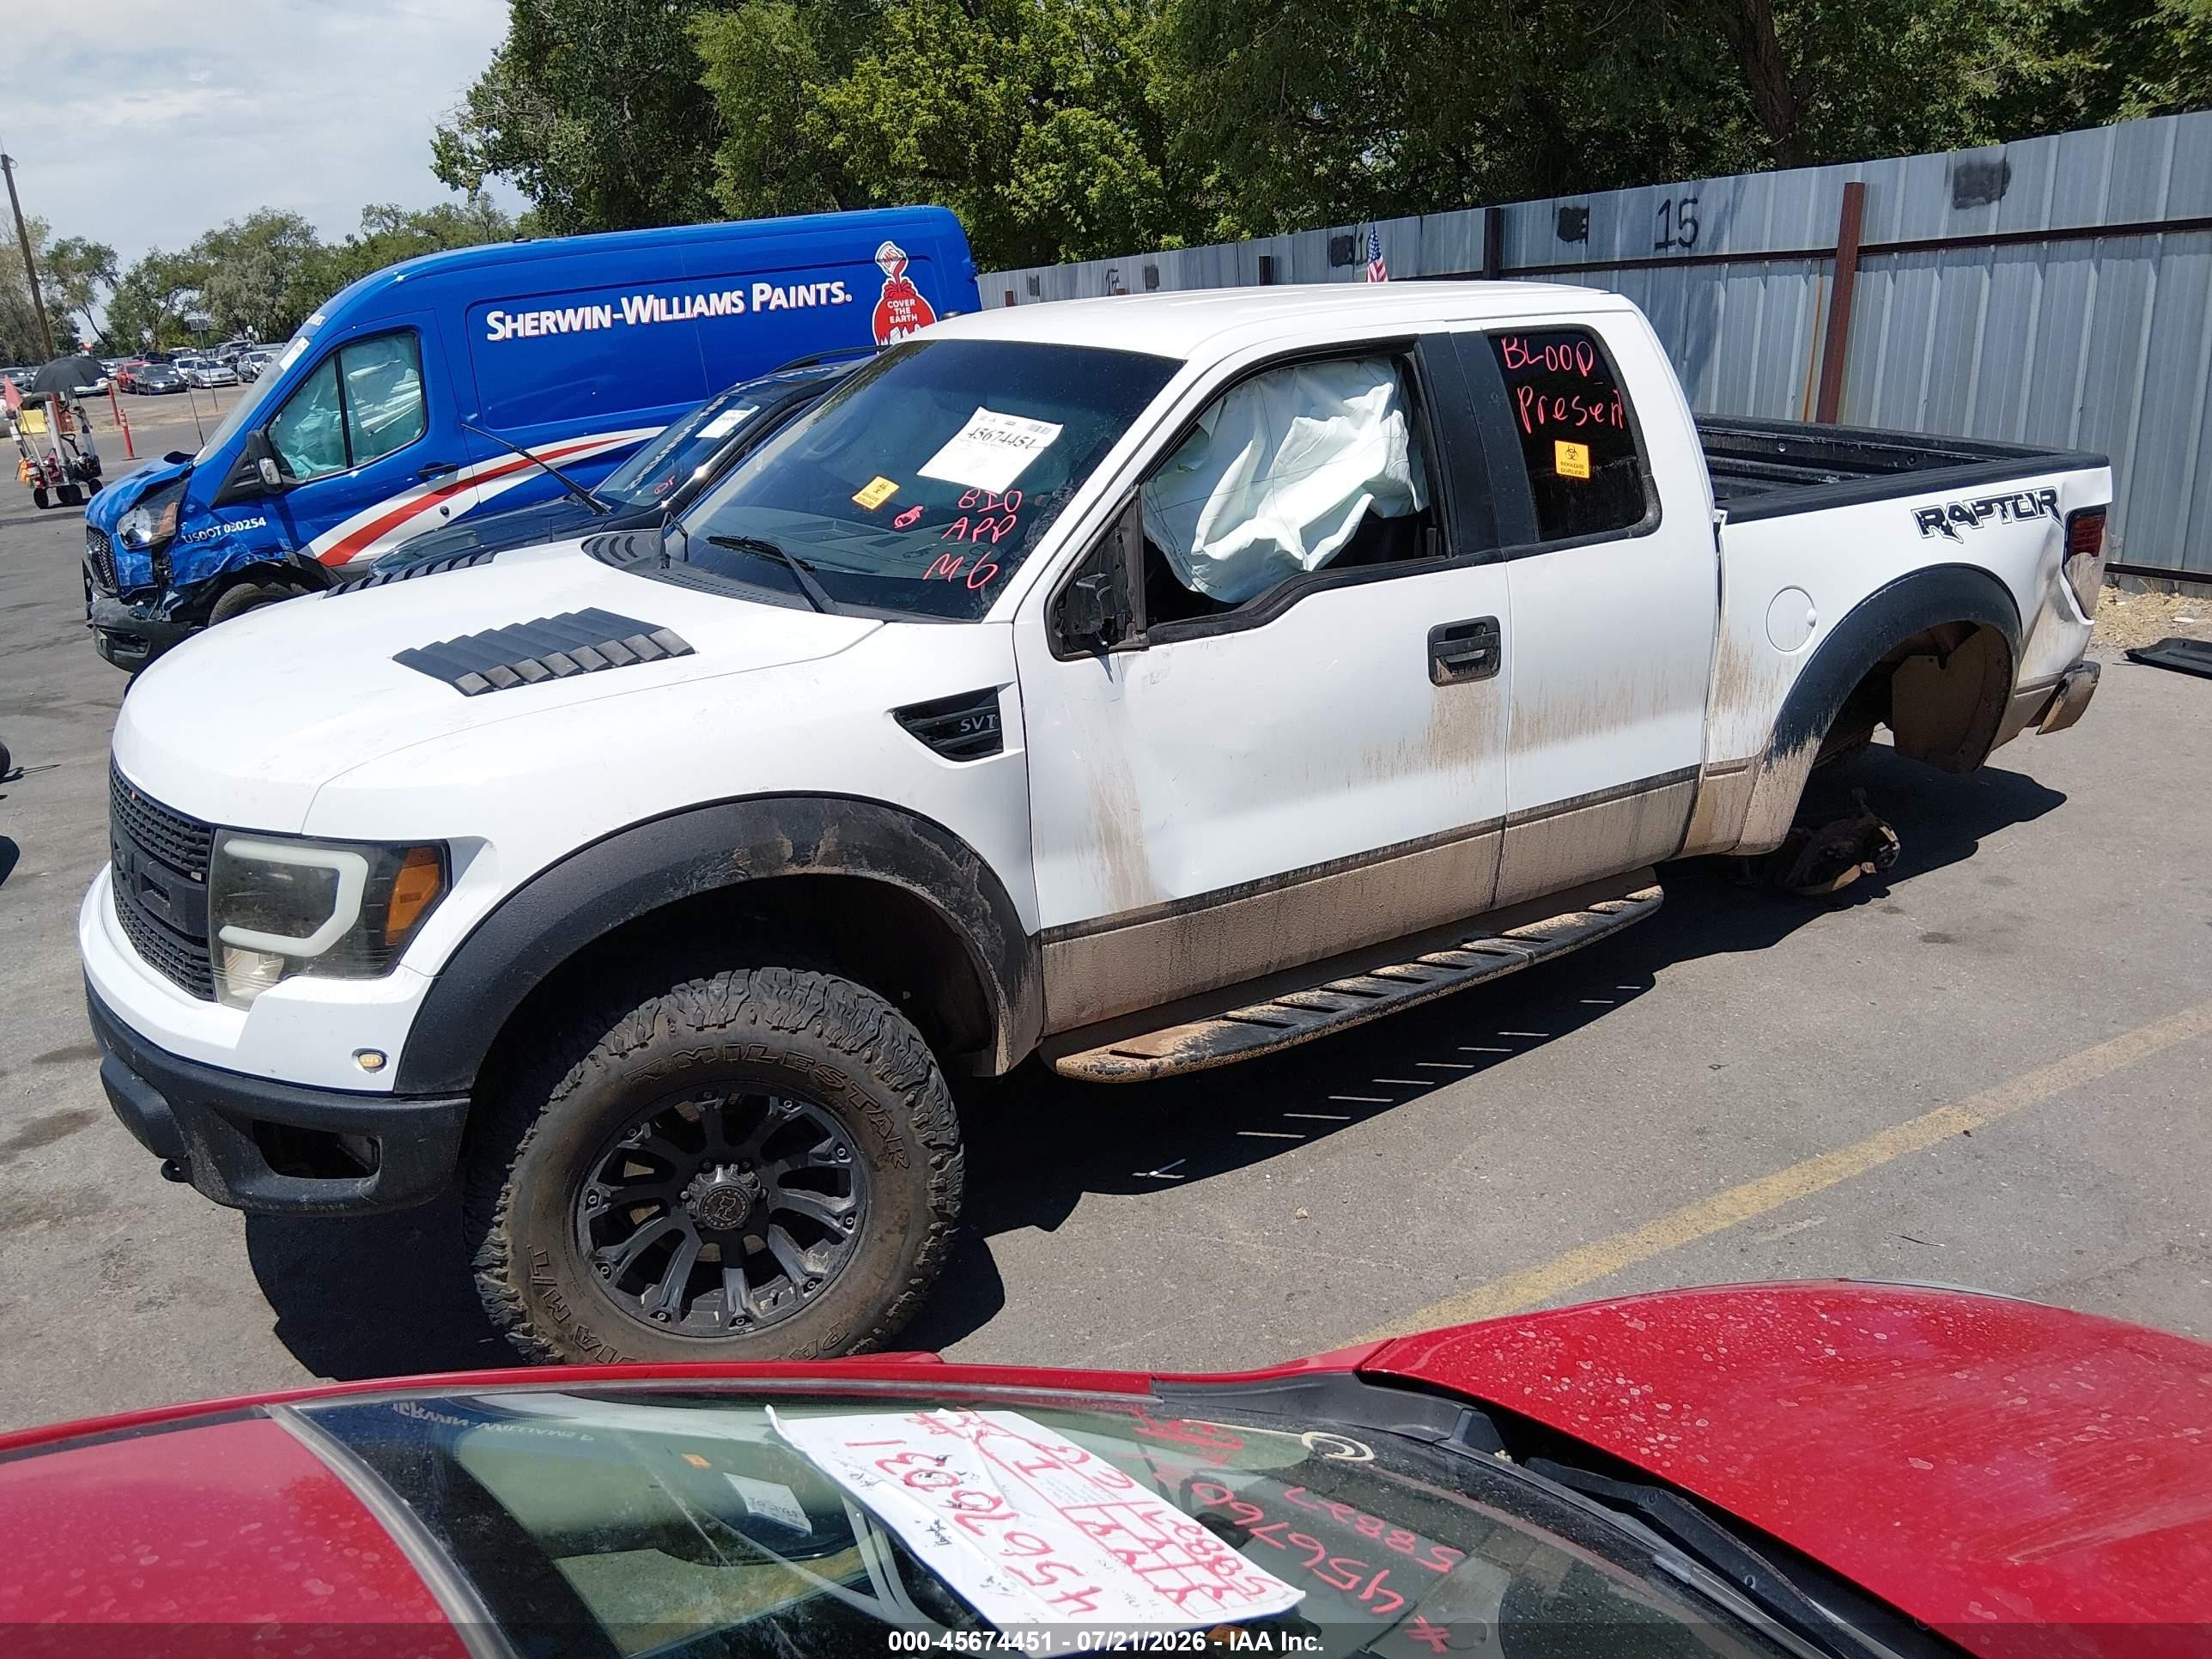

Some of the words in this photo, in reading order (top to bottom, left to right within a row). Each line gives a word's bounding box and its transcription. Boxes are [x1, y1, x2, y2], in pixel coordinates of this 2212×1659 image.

[1654, 197, 1699, 251] 15
[486, 289, 745, 342] SHERWIN-WILLIAMS
[886, 298, 916, 308] COVER
[889, 313, 918, 324] EARTH
[894, 307, 912, 315] THE
[1501, 336, 1595, 377] BLOOD
[968, 426, 1037, 450] 45674451
[957, 488, 1024, 513] BIO
[1911, 485, 2064, 544] RAPTOR
[181, 526, 222, 544] USDOT
[959, 713, 1000, 732] SVT
[672, 1042, 911, 1170] MILESTAR
[843, 1438, 1103, 1618] 45676031
[1283, 1486, 1467, 1573] 58827
